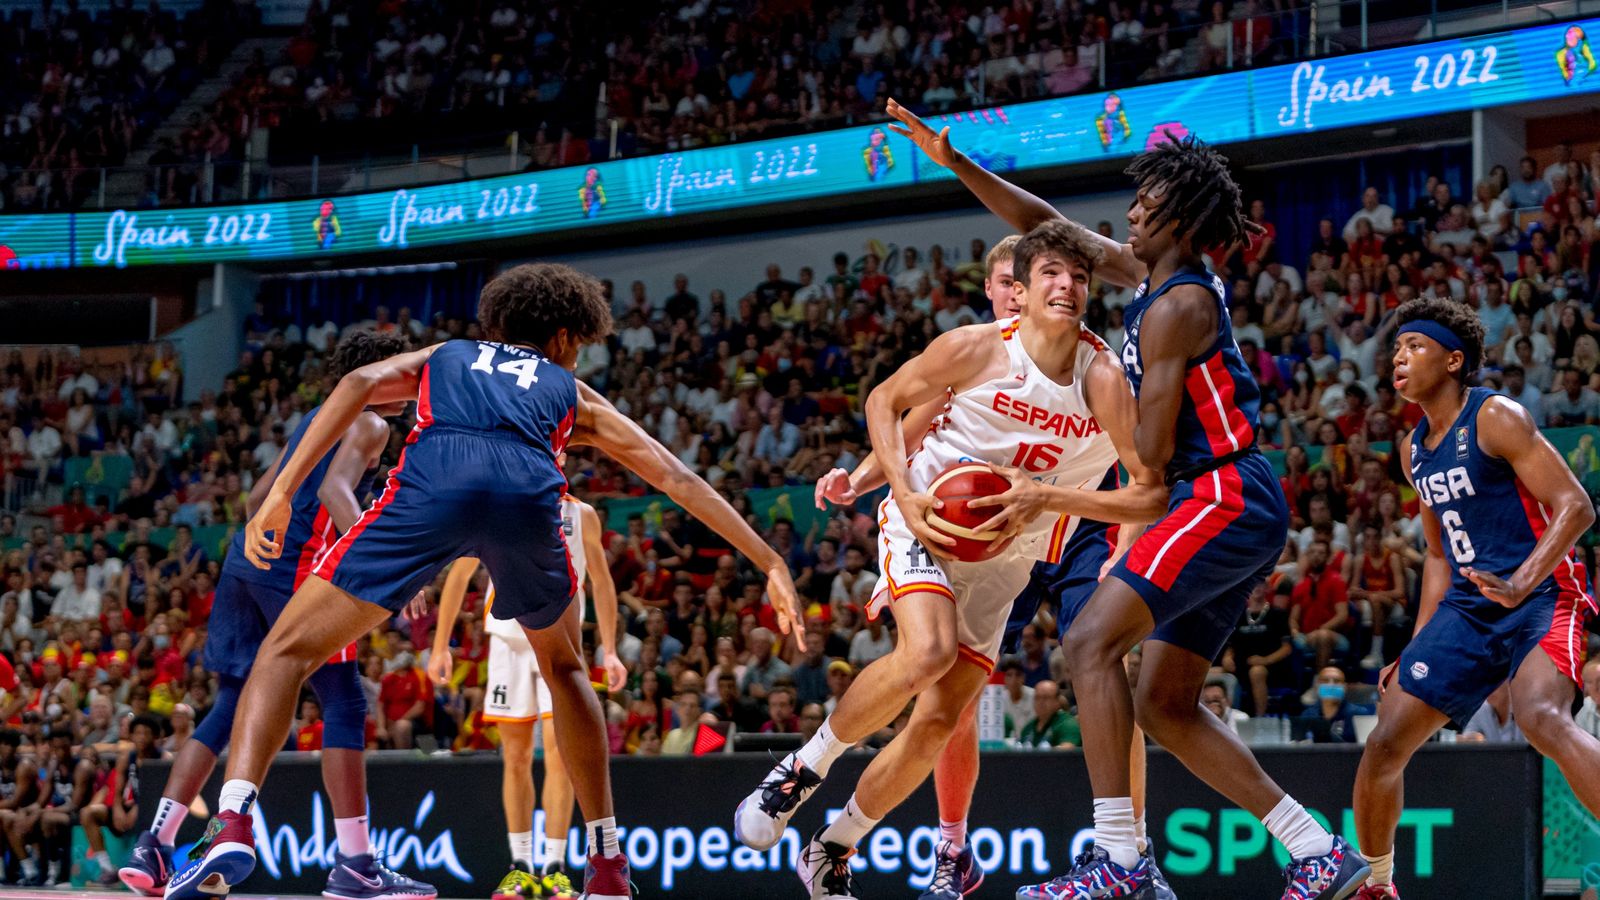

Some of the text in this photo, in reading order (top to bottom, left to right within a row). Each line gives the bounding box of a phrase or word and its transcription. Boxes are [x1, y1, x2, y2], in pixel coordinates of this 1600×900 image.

[1277, 46, 1499, 128] Spain 2022
[645, 143, 818, 214] Spain 2022
[93, 209, 271, 268] Spain 2022
[378, 183, 540, 246] Spain 2022
[470, 343, 539, 390] 14
[992, 391, 1103, 438] ESPAÑA
[1011, 441, 1064, 473] 16
[1415, 466, 1476, 507] USA
[1442, 510, 1476, 564] 6
[826, 808, 1050, 890] egon
